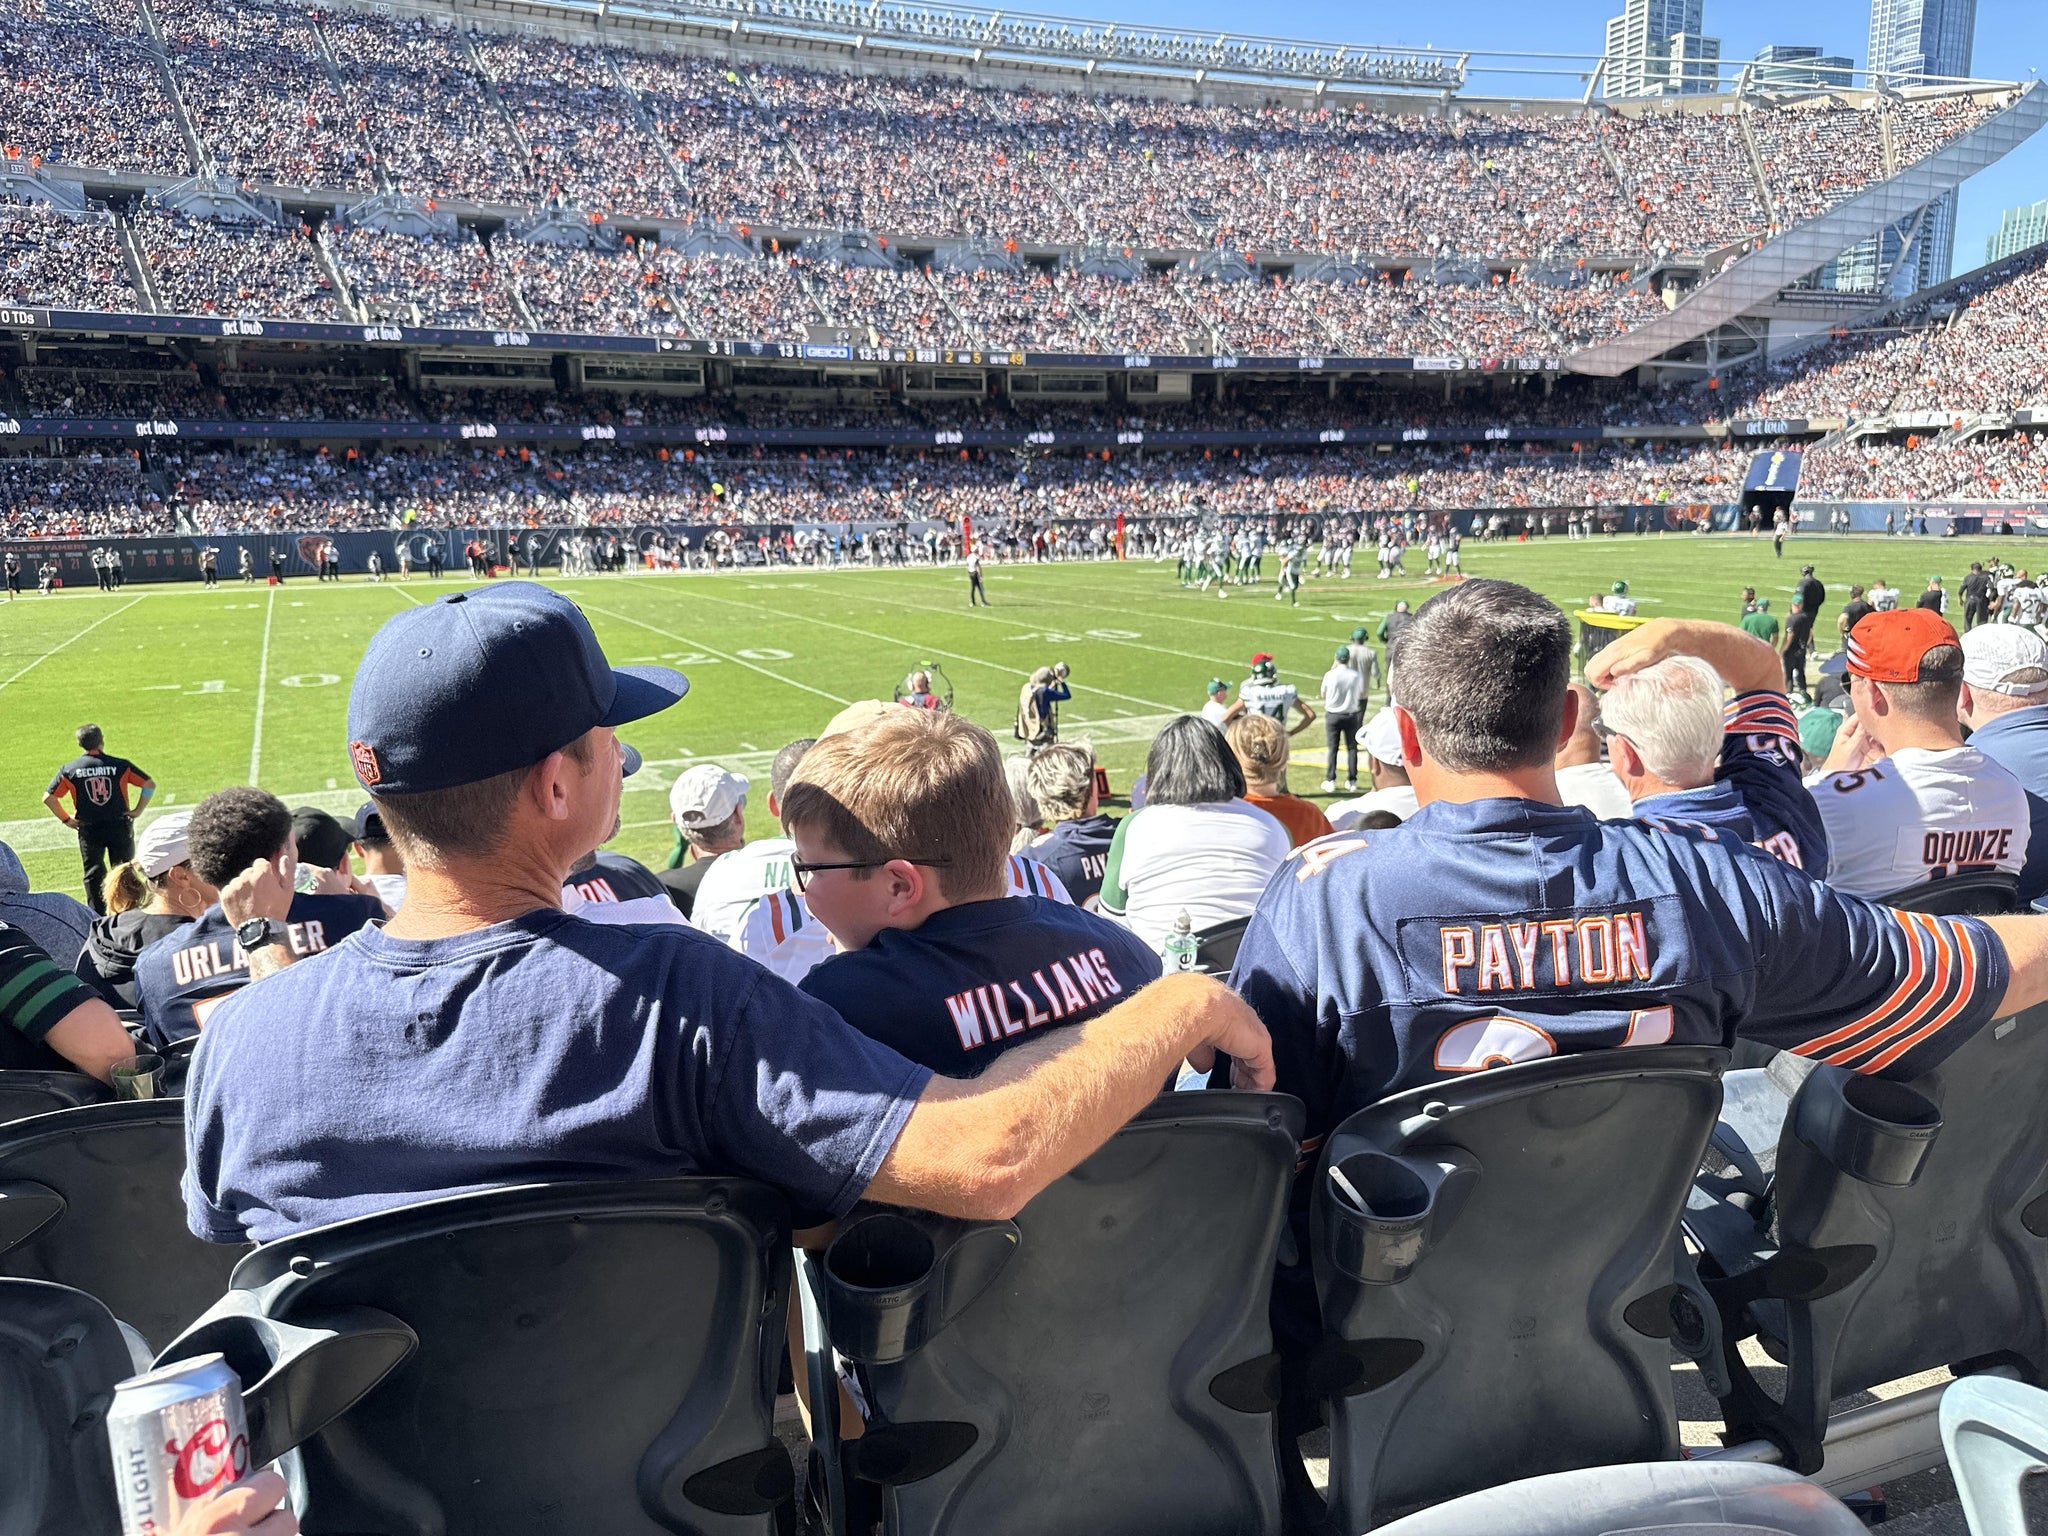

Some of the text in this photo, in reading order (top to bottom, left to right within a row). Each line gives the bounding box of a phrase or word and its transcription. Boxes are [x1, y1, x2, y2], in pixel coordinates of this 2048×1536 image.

[12, 311, 35, 325] TDs
[223, 321, 264, 336] get loud
[364, 327, 402, 342] get loud
[778, 344, 794, 358] 13
[806, 347, 848, 358] GEICO
[857, 347, 891, 361] 13:18
[906, 349, 914, 362] 3
[945, 351, 954, 363] 2
[973, 352, 982, 364] 5
[1009, 352, 1023, 365] 49
[0, 419, 20, 435] oud
[137, 421, 178, 436] get loud
[44, 543, 88, 551] FAMERS
[75, 766, 117, 778] SECURITY
[1923, 828, 2013, 865] ODUNZE
[172, 919, 327, 986] URLAER
[1440, 911, 1651, 993] PAYTON
[944, 946, 1122, 1052] WILLIAMS
[128, 1447, 153, 1518] LIGHT
